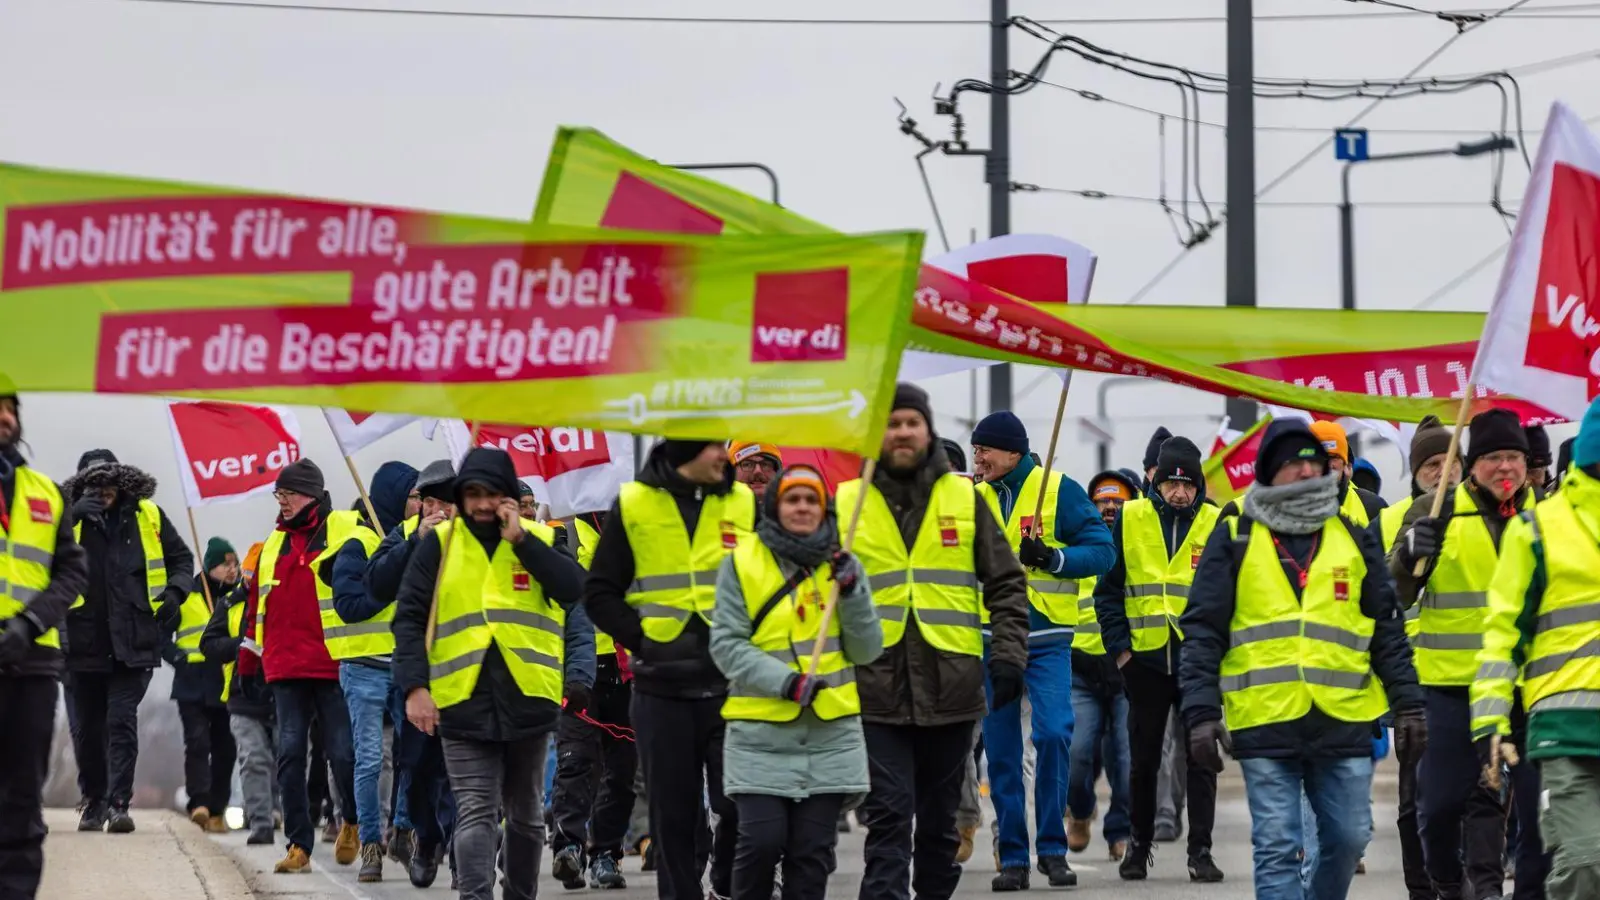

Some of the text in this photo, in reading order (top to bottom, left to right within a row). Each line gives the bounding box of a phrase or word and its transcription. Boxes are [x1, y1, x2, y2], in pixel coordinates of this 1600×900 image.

[1341, 133, 1362, 157] T
[19, 208, 408, 273] Mobilität für alle,
[372, 256, 634, 322] gute Arbeit
[115, 315, 616, 380] für die Beschäftigten!
[757, 322, 841, 351] ver.di
[193, 441, 298, 480] ver.di
